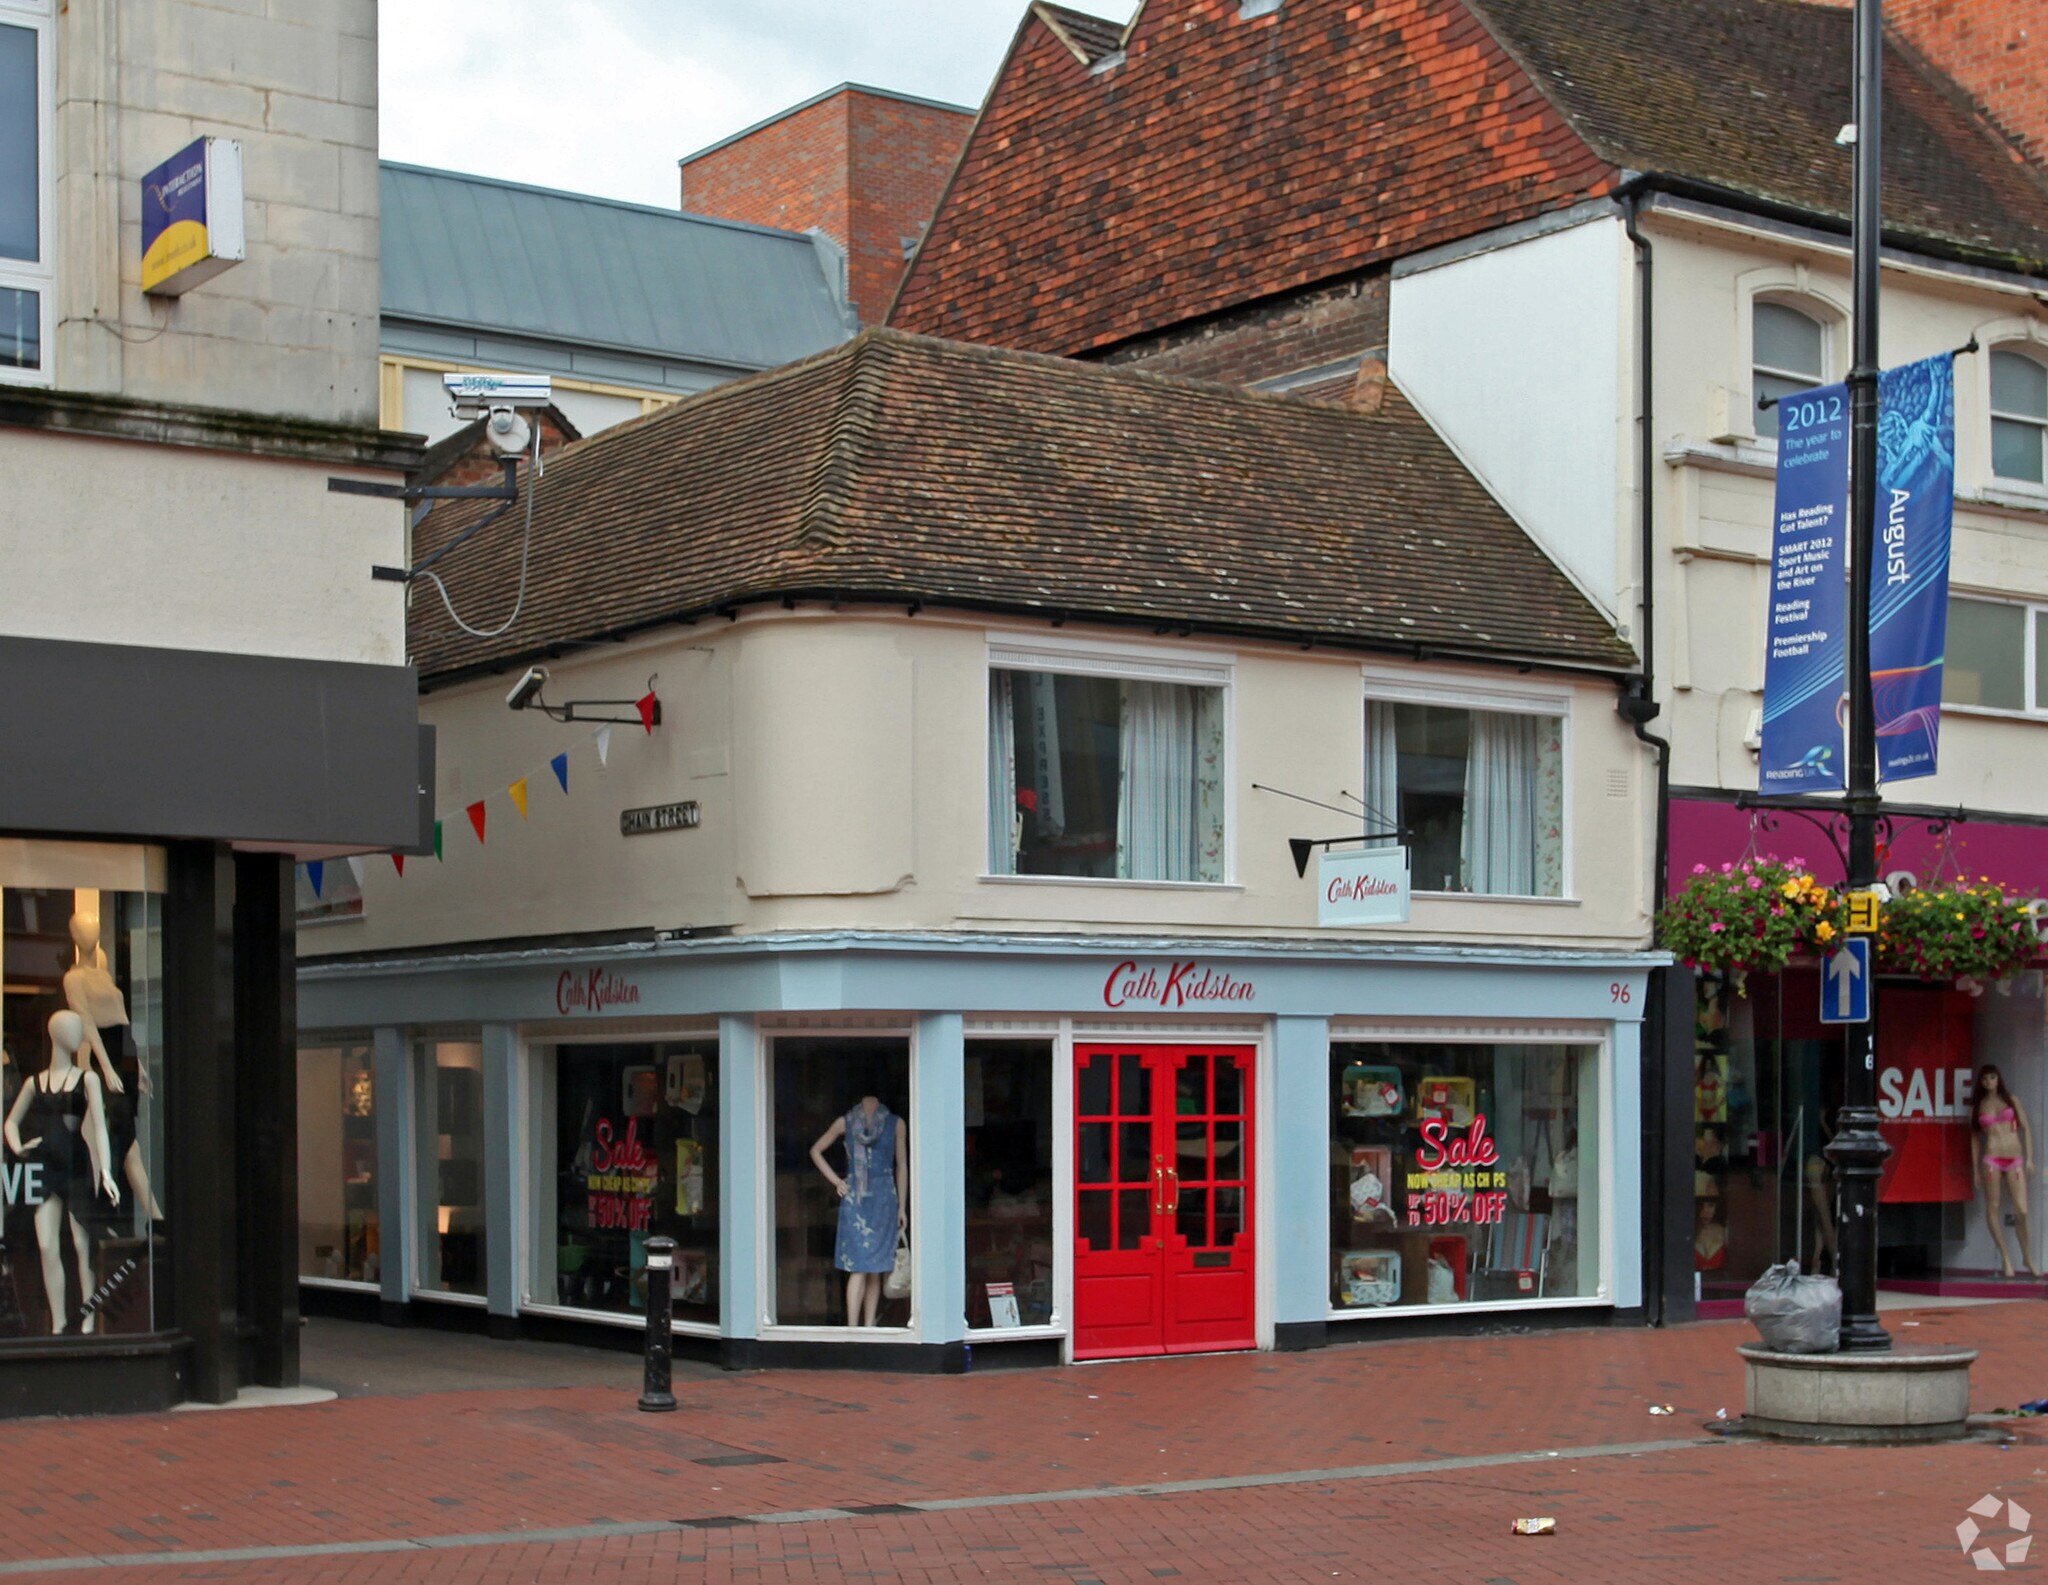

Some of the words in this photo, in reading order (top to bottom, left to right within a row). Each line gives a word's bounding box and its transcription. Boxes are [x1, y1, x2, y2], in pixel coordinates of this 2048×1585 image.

[1787, 397, 1842, 431] 2012
[1786, 438, 1804, 450] The
[1805, 433, 1828, 448] year
[1831, 430, 1842, 440] to
[1784, 450, 1829, 468] celebrate
[1780, 512, 1797, 522] Has
[1798, 504, 1833, 518] Reading
[1780, 522, 1796, 533] Got
[1797, 515, 1828, 529] Talent?
[1779, 541, 1808, 556] SMART
[1810, 537, 1833, 550] 2012
[1883, 488, 1911, 586] August
[1778, 555, 1801, 569] Sport
[1802, 550, 1830, 562] Music
[1777, 567, 1794, 579] and
[1794, 564, 1809, 576] Art
[1810, 564, 1823, 573] on
[1777, 581, 1792, 591] the
[1793, 577, 1816, 588] River
[1775, 599, 1810, 613] Reading
[1775, 610, 1808, 624] Festival
[1774, 630, 1828, 647] Premiership
[1773, 644, 1809, 658] Football
[655, 804, 697, 829] STREET
[1327, 876, 1352, 904] Cath
[1353, 874, 1398, 901] Kidston
[557, 969, 587, 1015] Cath
[588, 966, 640, 1012] Kidston
[1104, 960, 1160, 1008] Cath
[1160, 960, 1255, 1008] Kidston
[1610, 982, 1631, 1004] 96
[1879, 1066, 1973, 1118] SALE
[593, 1114, 647, 1172] Sale
[1415, 1113, 1500, 1170] Sale
[1407, 1173, 1430, 1189] NOW
[1463, 1172, 1476, 1188] AS
[1408, 1193, 1420, 1209] UP
[1424, 1191, 1470, 1225] 50%
[1472, 1191, 1508, 1225] OFF
[628, 1197, 652, 1232] OFF
[1408, 1210, 1420, 1226] TO
[80, 1258, 137, 1317] STUDENTS
